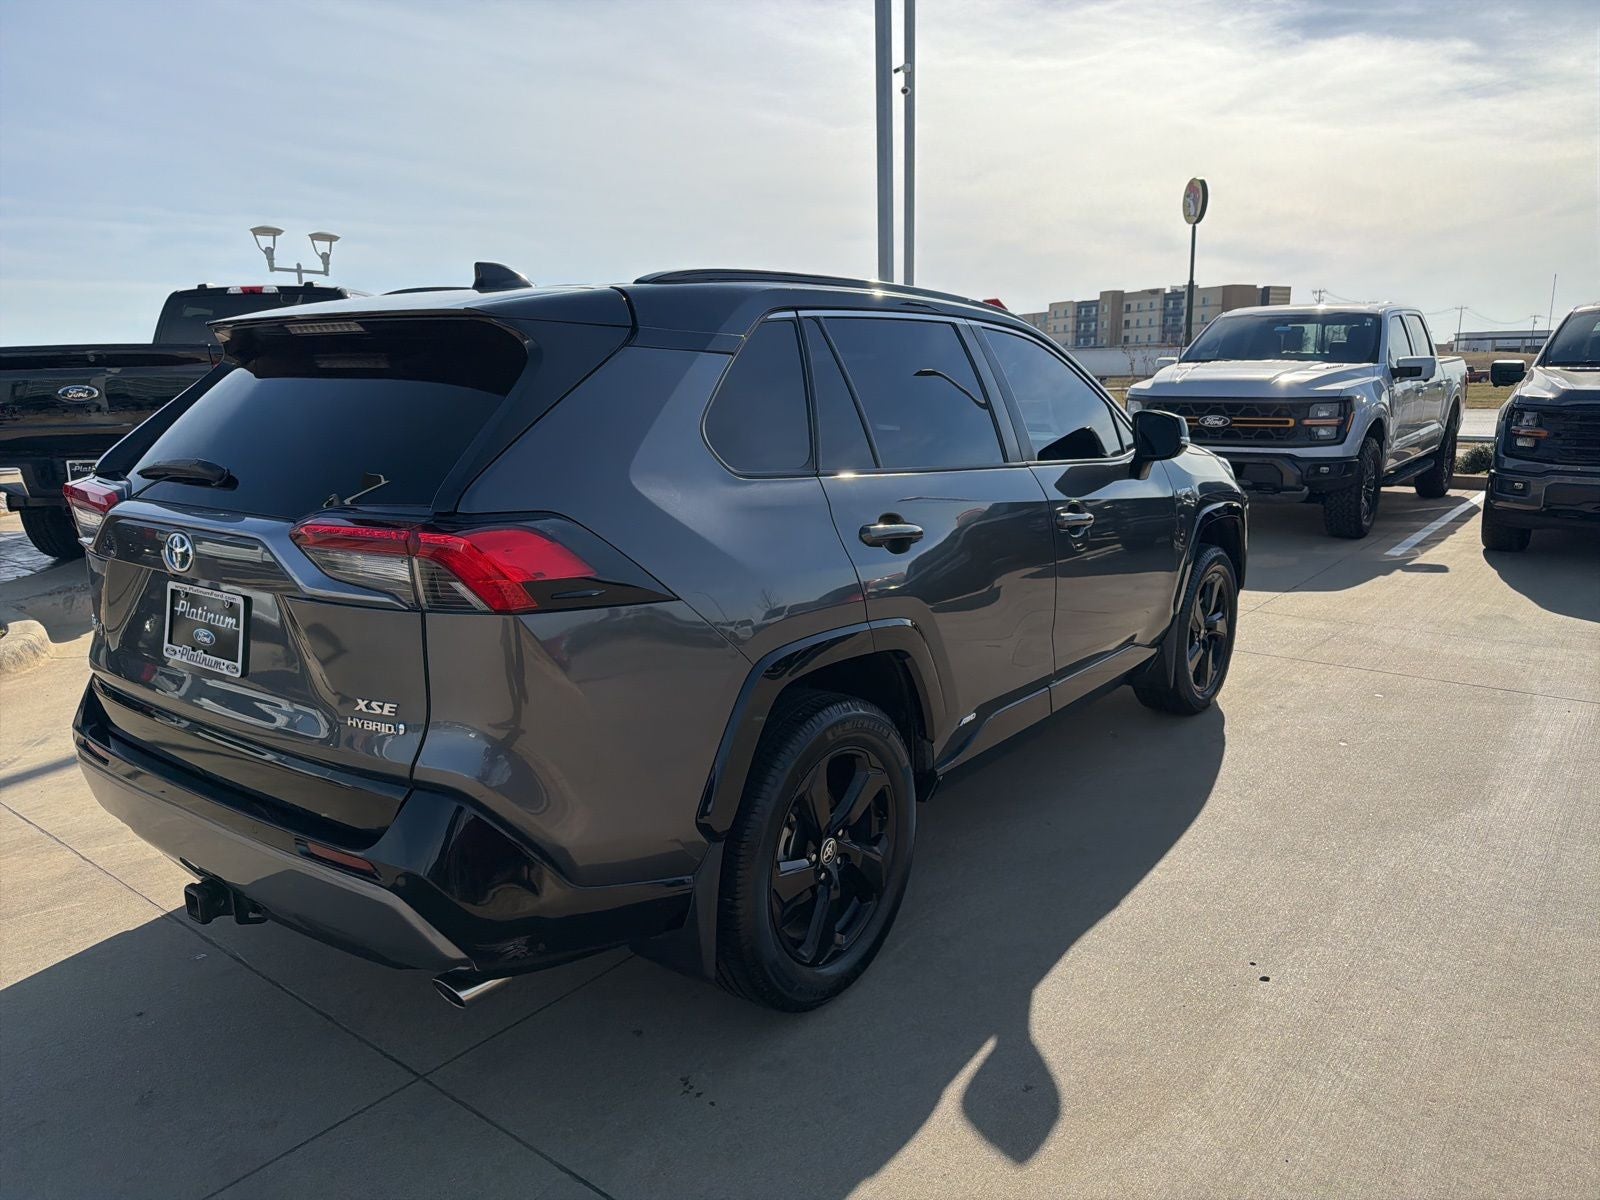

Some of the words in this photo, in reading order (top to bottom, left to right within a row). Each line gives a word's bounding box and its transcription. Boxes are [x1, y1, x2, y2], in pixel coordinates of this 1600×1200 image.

[174, 599, 240, 631] Platinum
[196, 630, 212, 644] Ford
[180, 646, 226, 671] Platinum
[353, 698, 398, 716] XSE
[347, 716, 395, 735] HYBRID
